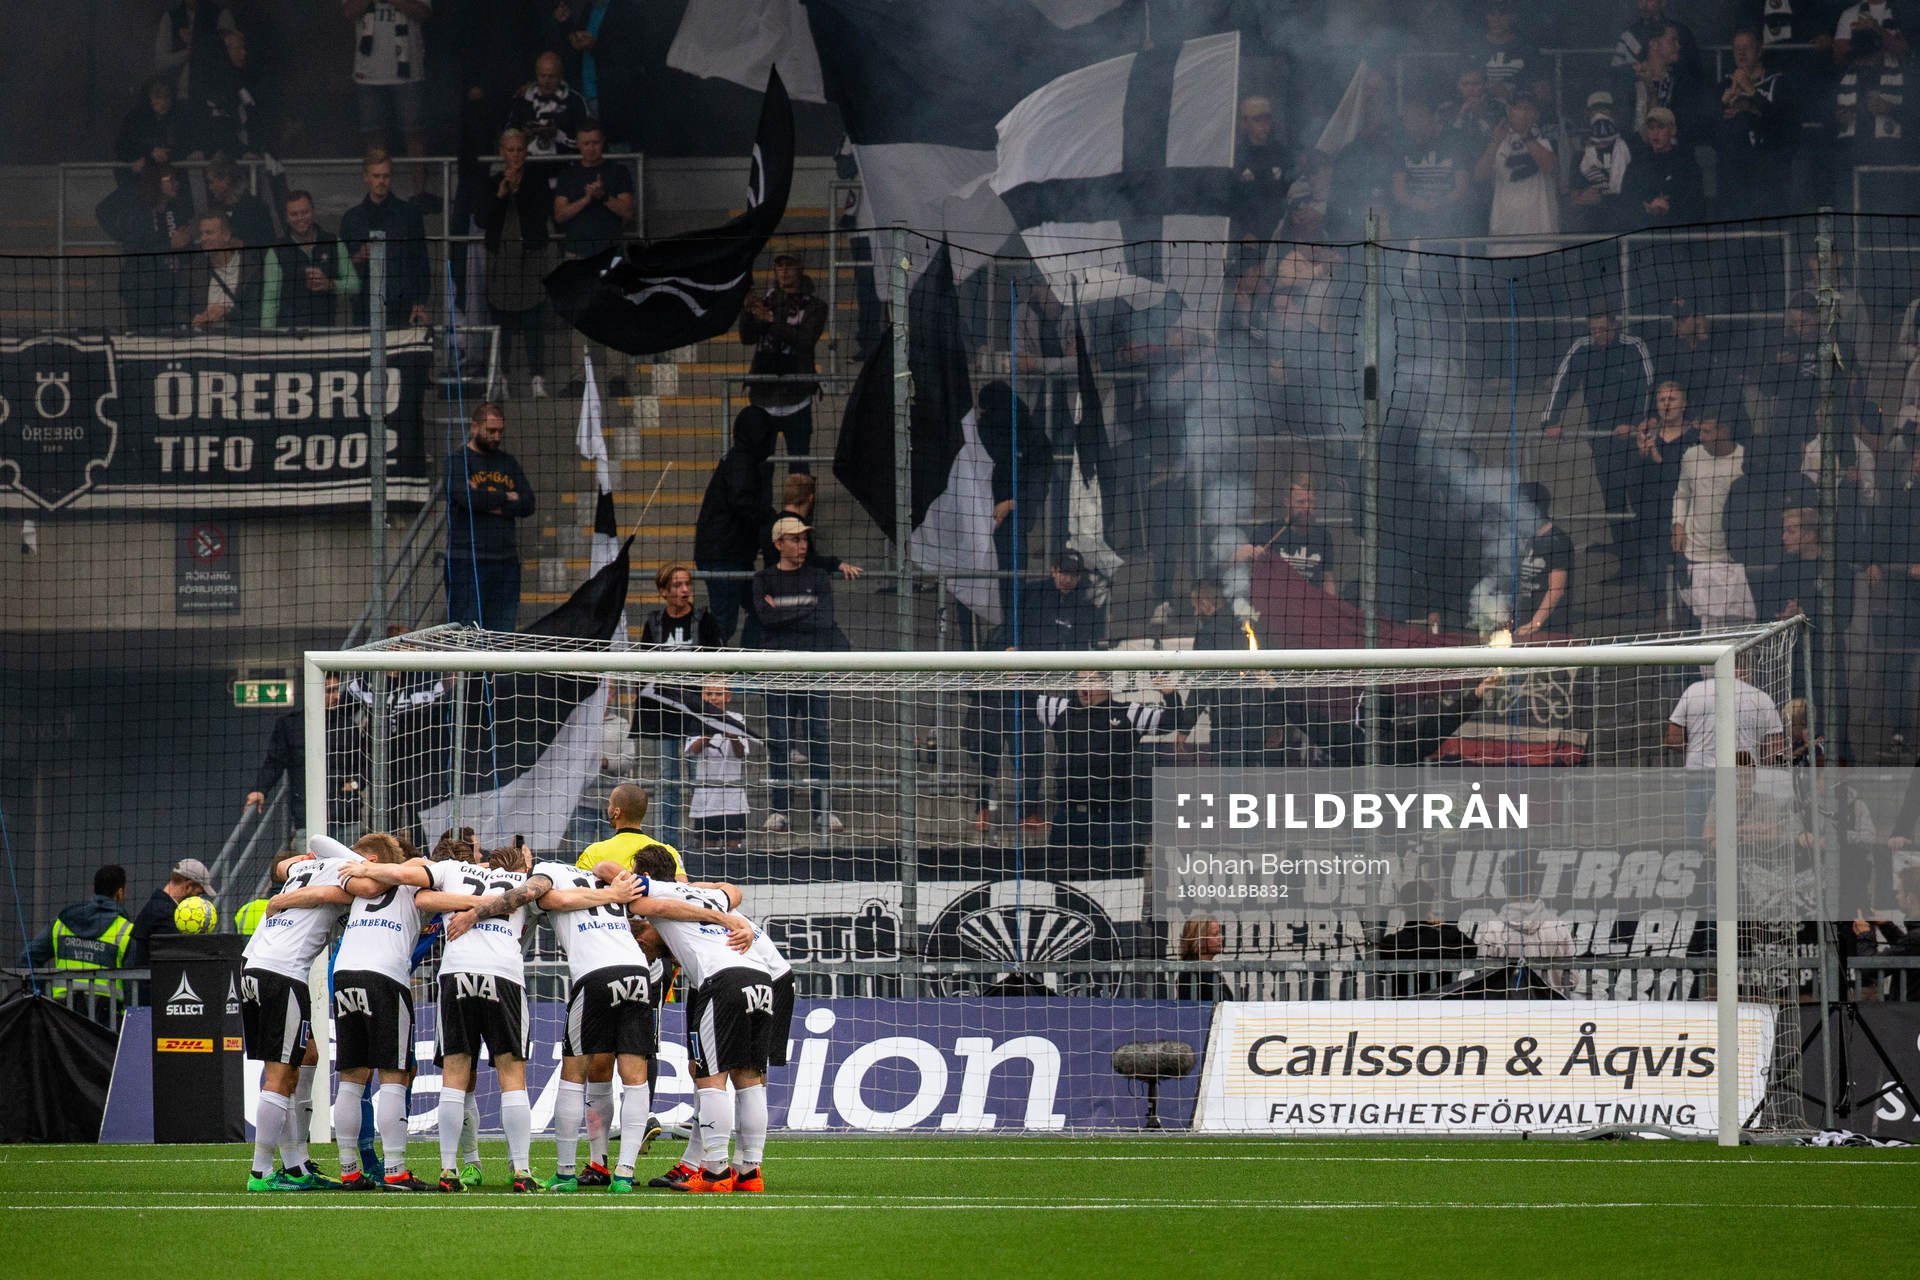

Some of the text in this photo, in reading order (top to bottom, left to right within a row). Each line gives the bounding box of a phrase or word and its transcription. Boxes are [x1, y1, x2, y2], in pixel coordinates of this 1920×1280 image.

[154, 362, 400, 420] ÖREBRO
[22, 425, 84, 440] ÖREBRO
[154, 436, 254, 472] TIFO
[65, 937, 106, 952] ORDNINGS
[454, 972, 499, 1002] NA
[607, 975, 649, 1007] NA
[742, 984, 774, 1015] NA
[166, 1004, 204, 1016] SELECT
[334, 987, 372, 1018] NA
[165, 1040, 205, 1050] DHL
[1247, 1022, 1718, 1091] Carlsson & Åqvis
[1269, 1098, 1697, 1125] FASTIGHETSFÖRVALTNING
